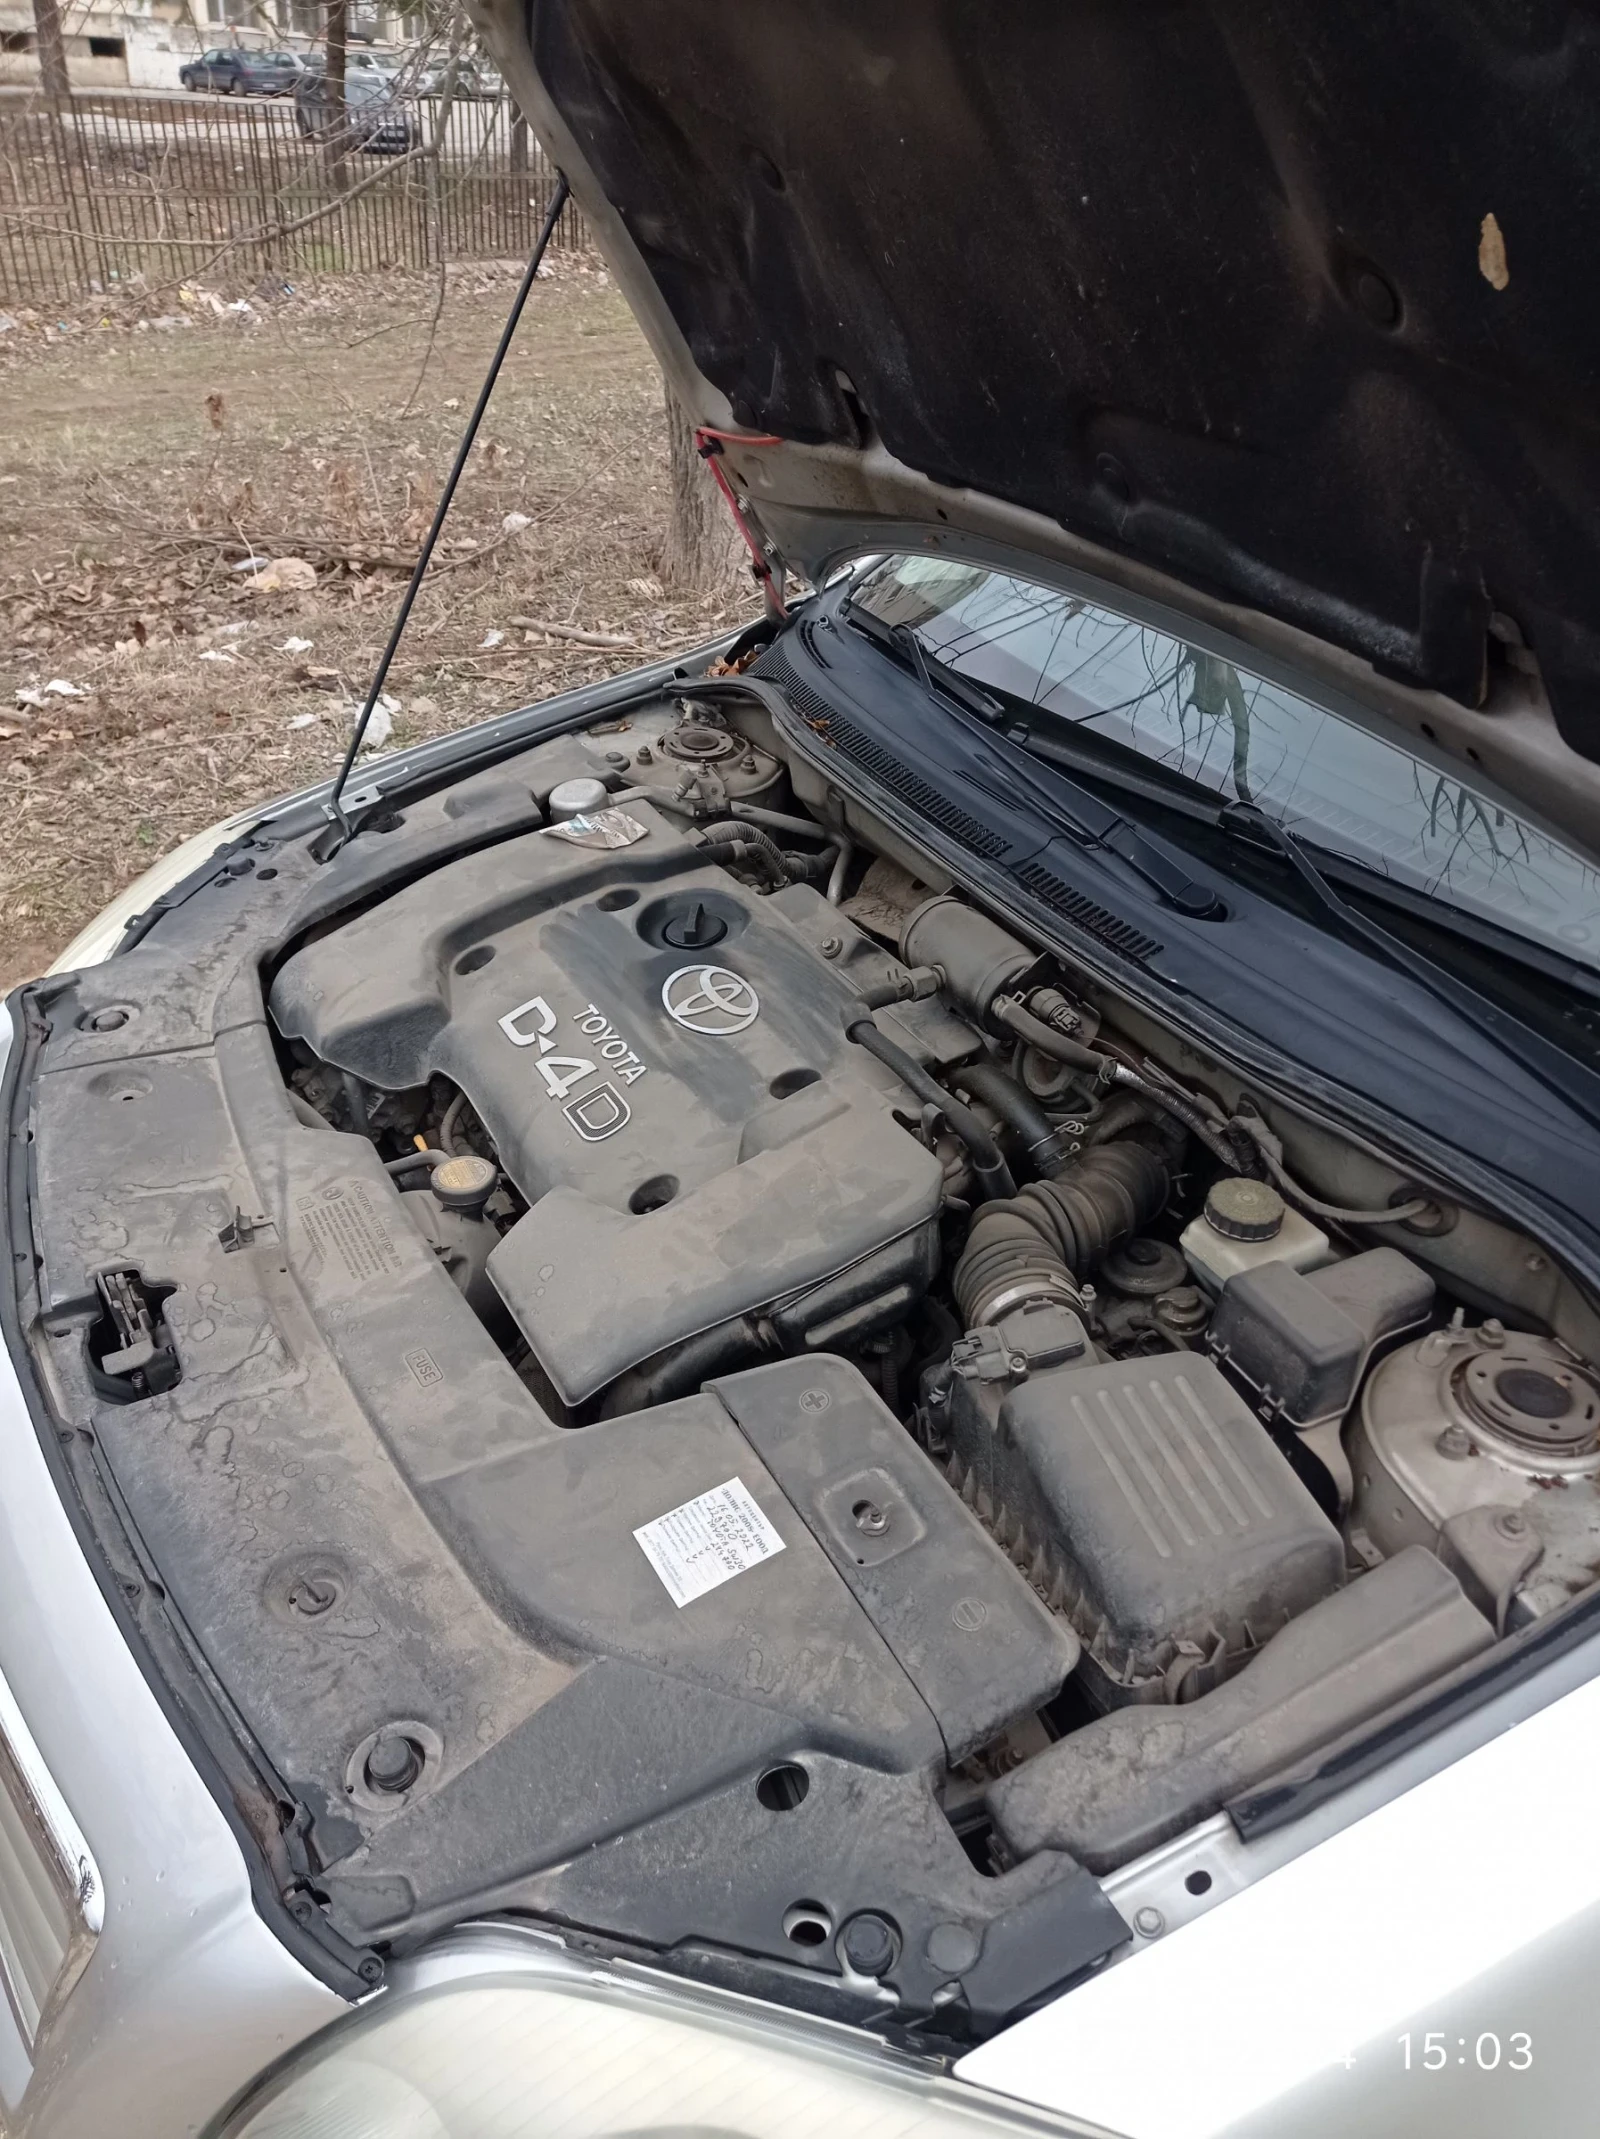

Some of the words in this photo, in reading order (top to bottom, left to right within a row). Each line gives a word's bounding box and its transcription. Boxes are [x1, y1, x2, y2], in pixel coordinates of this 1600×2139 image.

[573, 1003, 648, 1086] TOYOTA
[354, 1185, 373, 1214] CAUTION
[370, 1213, 396, 1257] ATTENTION
[411, 1353, 437, 1382] FUSE
[751, 1533, 769, 1554] ЕООД
